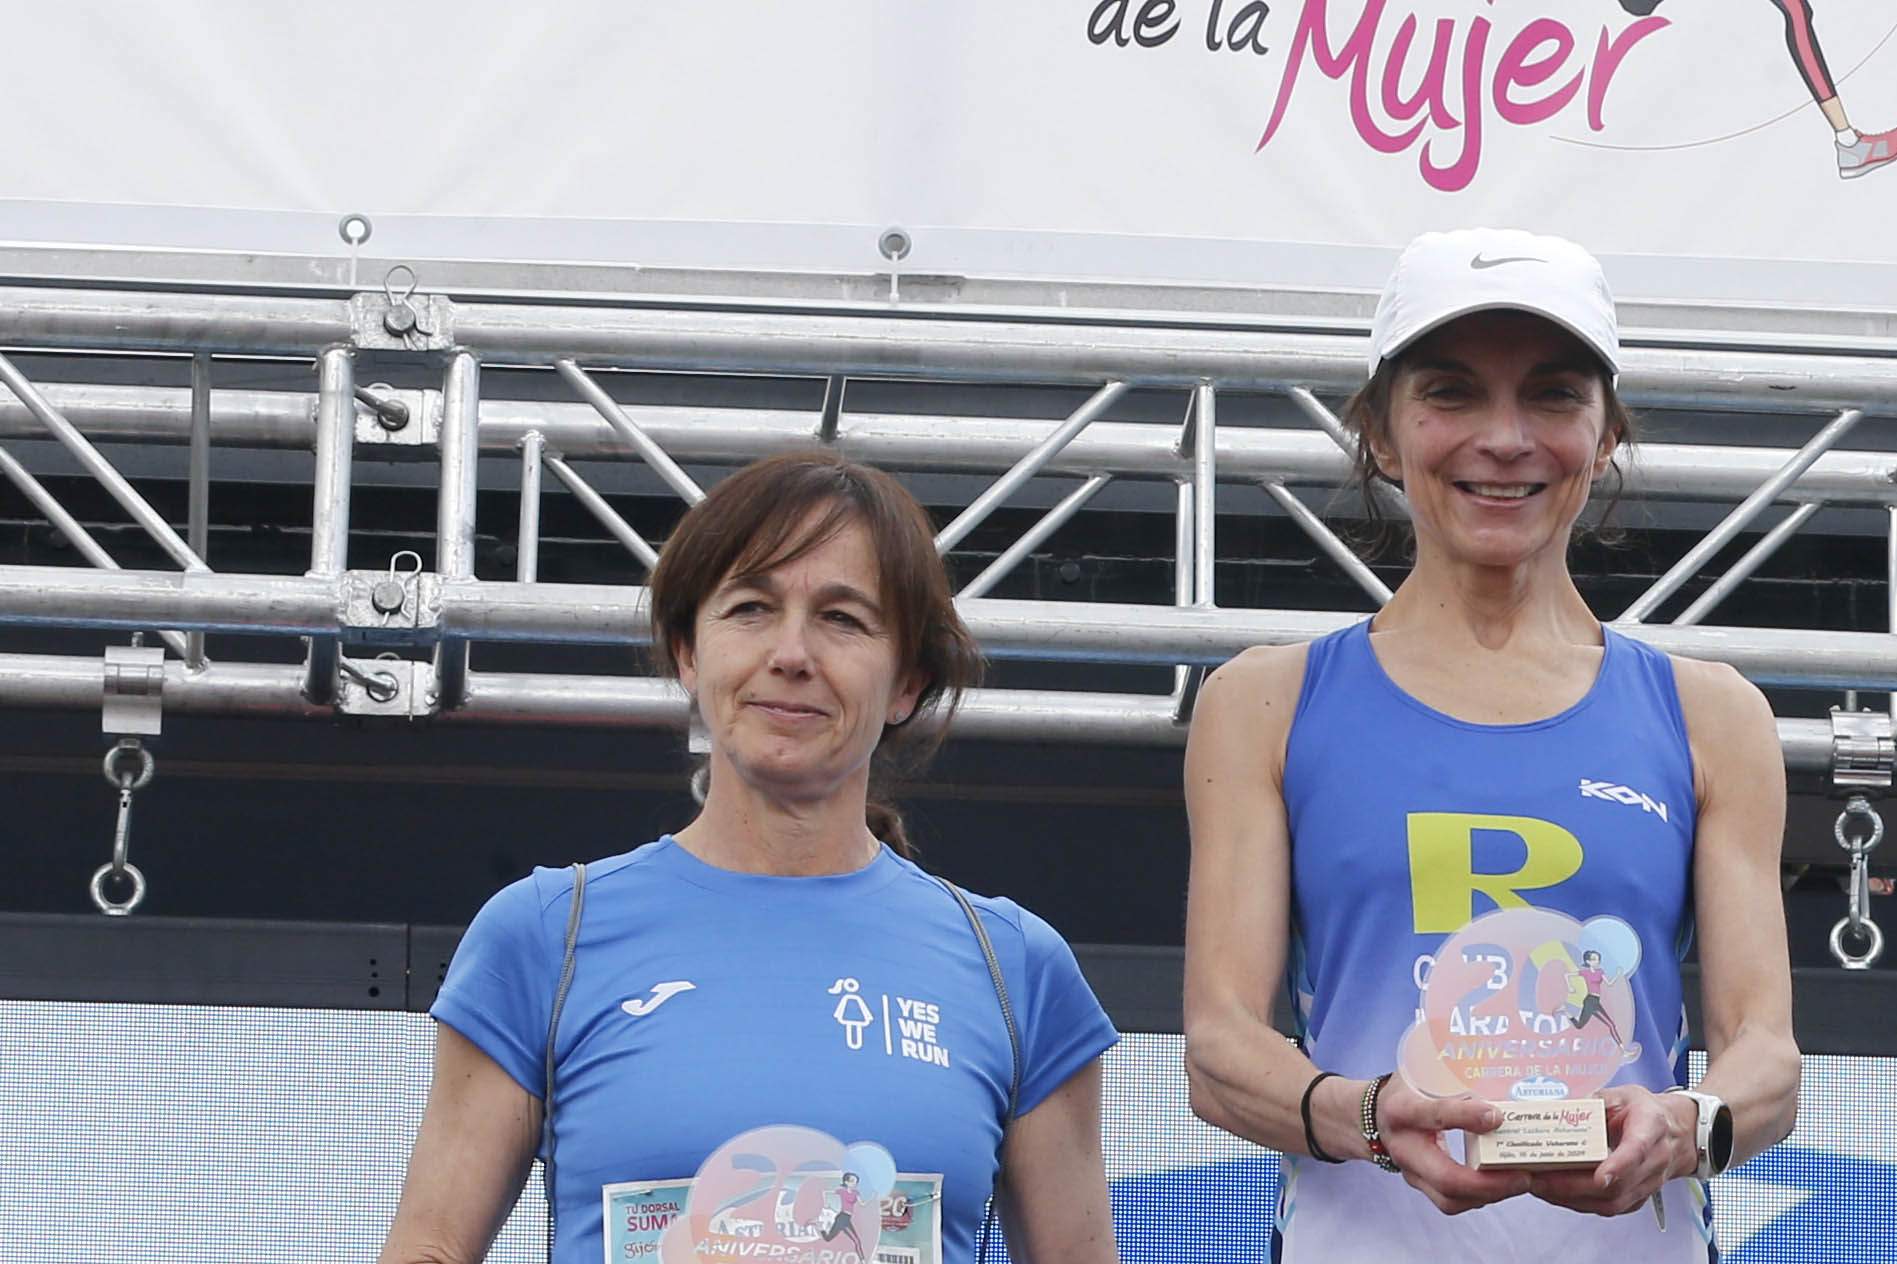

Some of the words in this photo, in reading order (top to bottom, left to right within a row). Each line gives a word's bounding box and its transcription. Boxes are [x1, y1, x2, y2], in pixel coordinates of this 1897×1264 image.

[1256, 0, 1672, 192] Mujer
[1407, 812, 1584, 933] R
[896, 997, 940, 1024] YES
[898, 1017, 937, 1044] WE
[901, 1038, 950, 1068] RUN
[1506, 1110, 1542, 1122] Carrera
[1558, 1108, 1593, 1127] Mujer
[625, 1204, 639, 1215] TU
[641, 1201, 681, 1214] DORSAL
